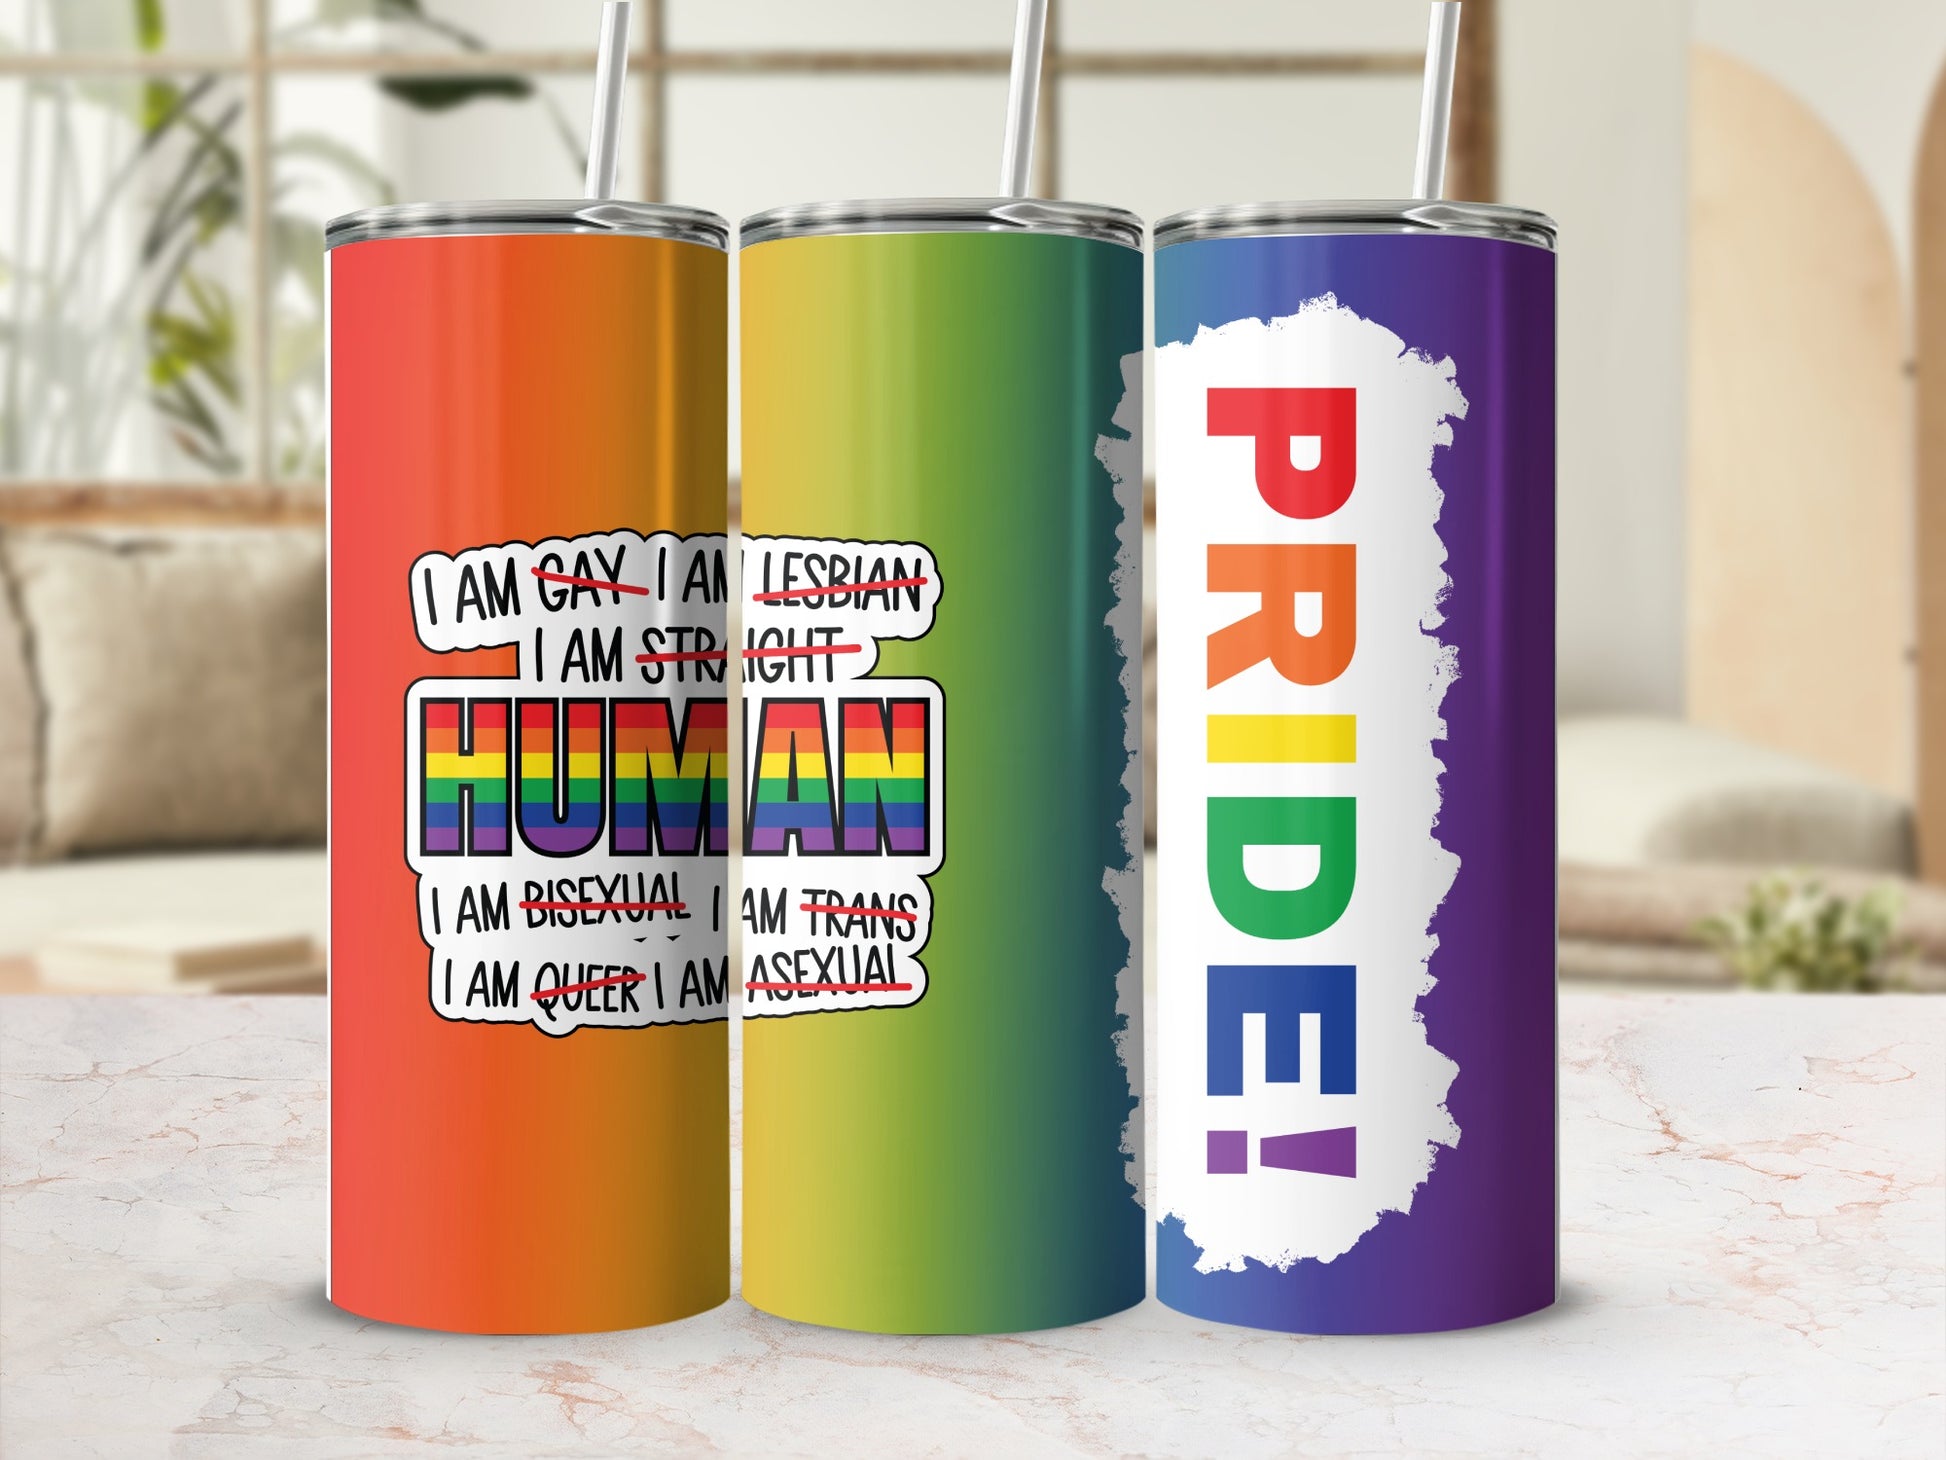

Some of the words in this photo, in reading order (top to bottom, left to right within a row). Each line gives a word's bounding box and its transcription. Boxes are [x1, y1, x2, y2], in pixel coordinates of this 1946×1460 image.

[424, 567, 437, 625] I
[456, 557, 521, 623] AM
[536, 545, 628, 612] GAY
[658, 546, 666, 600] I
[762, 550, 922, 612] LESBIAN
[534, 626, 543, 682] I
[561, 626, 623, 682] AM
[420, 697, 930, 857] HUMAN
[1206, 386, 1357, 1180] PRIDE!
[432, 887, 441, 935] I
[457, 882, 510, 934] AM
[523, 871, 692, 929] BISEXUAL
[712, 885, 720, 932] I
[742, 887, 787, 936] AM
[801, 887, 918, 942] TRANS
[445, 959, 452, 1005] I
[466, 960, 520, 1007] AM
[533, 961, 642, 1021] QUEER
[654, 962, 664, 1009] I
[679, 955, 729, 1008] AM
